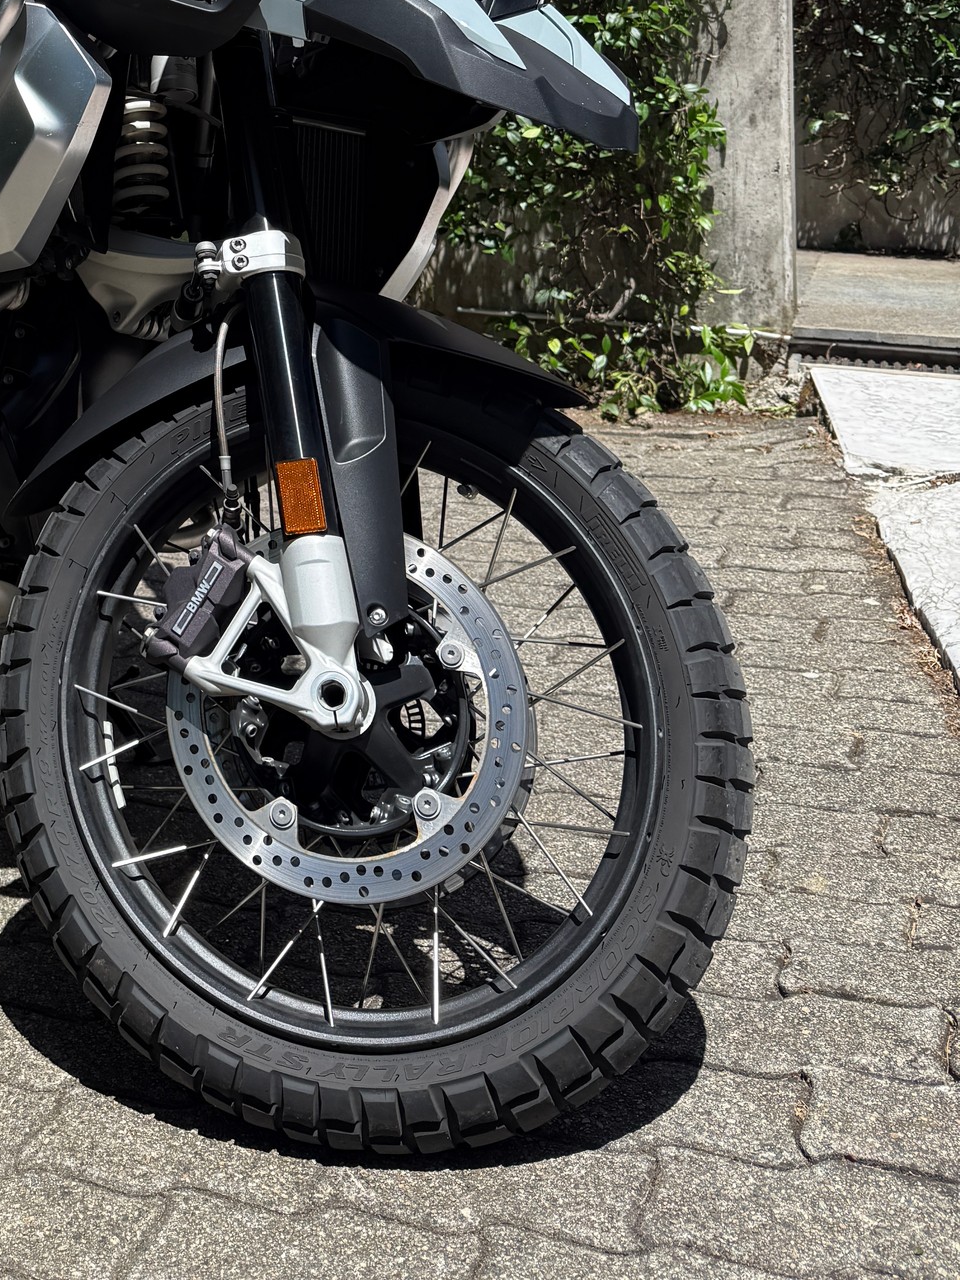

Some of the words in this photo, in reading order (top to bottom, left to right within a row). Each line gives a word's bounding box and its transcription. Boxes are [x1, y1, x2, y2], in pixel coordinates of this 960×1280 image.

[579, 512, 647, 592] PIRELLI
[185, 579, 210, 614] BMW
[478, 884, 658, 1066] SCORPION
[217, 1025, 310, 1071] STR
[316, 1053, 467, 1083] RALLY
